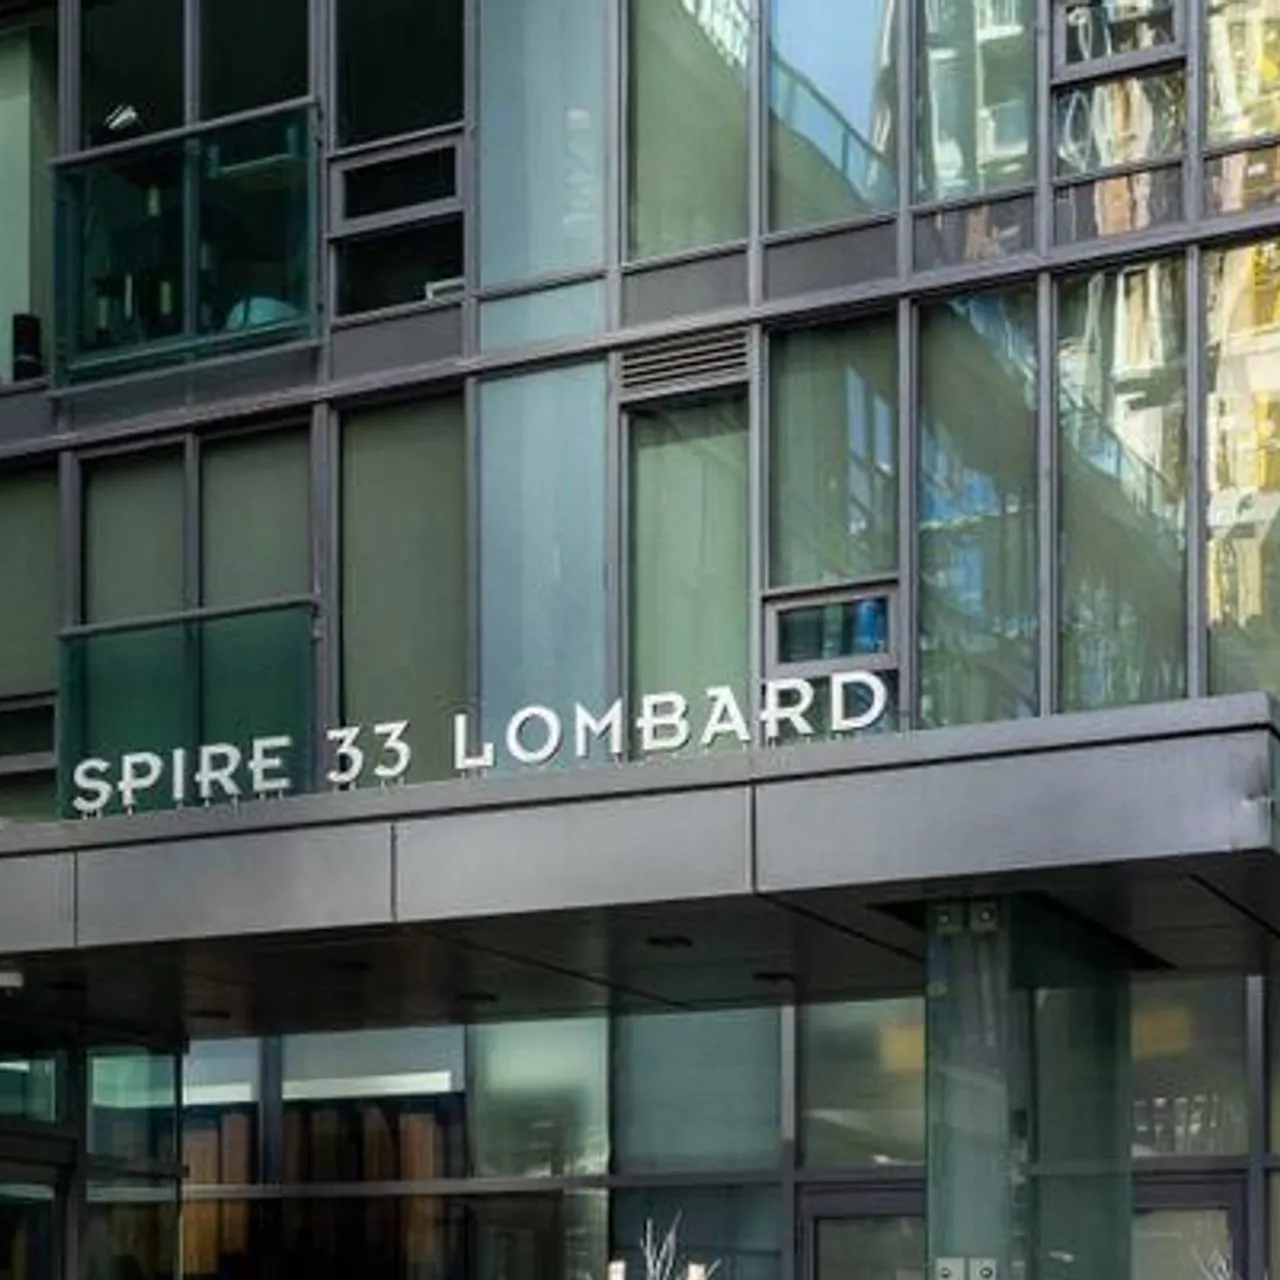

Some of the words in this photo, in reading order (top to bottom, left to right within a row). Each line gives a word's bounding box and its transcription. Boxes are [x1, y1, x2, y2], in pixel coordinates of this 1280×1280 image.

[72, 735, 292, 812] SPIRE
[324, 720, 412, 785] 33
[452, 670, 889, 770] LOMBARD
